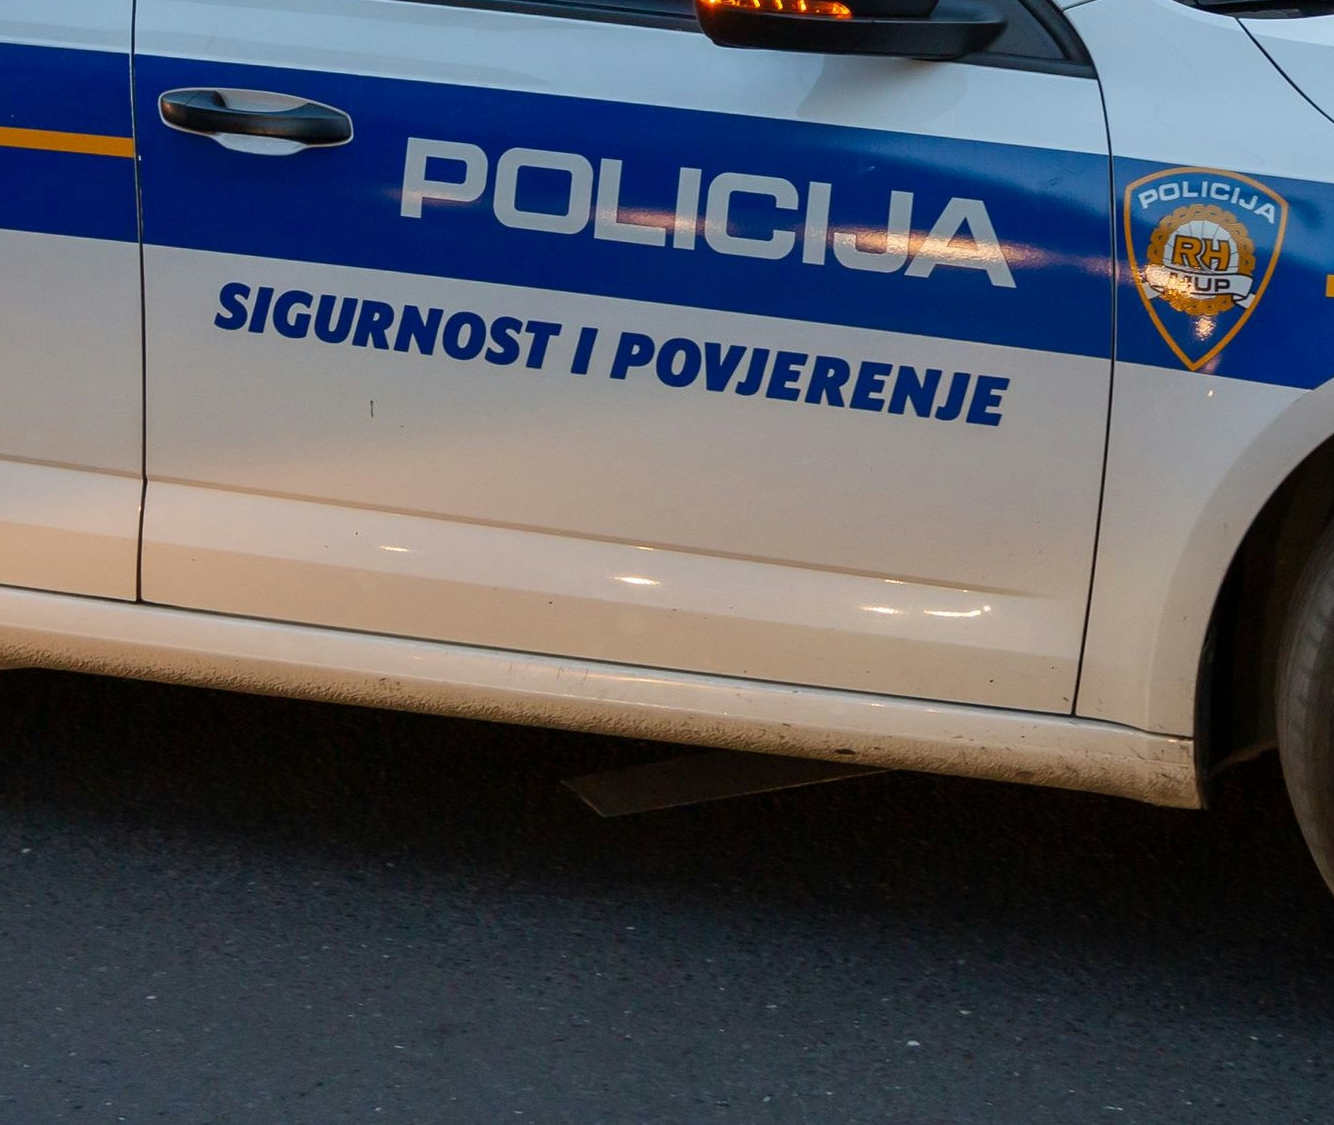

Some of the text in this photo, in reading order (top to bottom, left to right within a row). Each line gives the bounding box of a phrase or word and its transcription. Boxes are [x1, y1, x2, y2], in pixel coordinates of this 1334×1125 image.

[400, 136, 1016, 290] POLICIJA
[1138, 181, 1276, 224] POLICIJA
[1171, 234, 1231, 272] RH
[214, 282, 1011, 428] SIGURNOST I POVJERENJE
